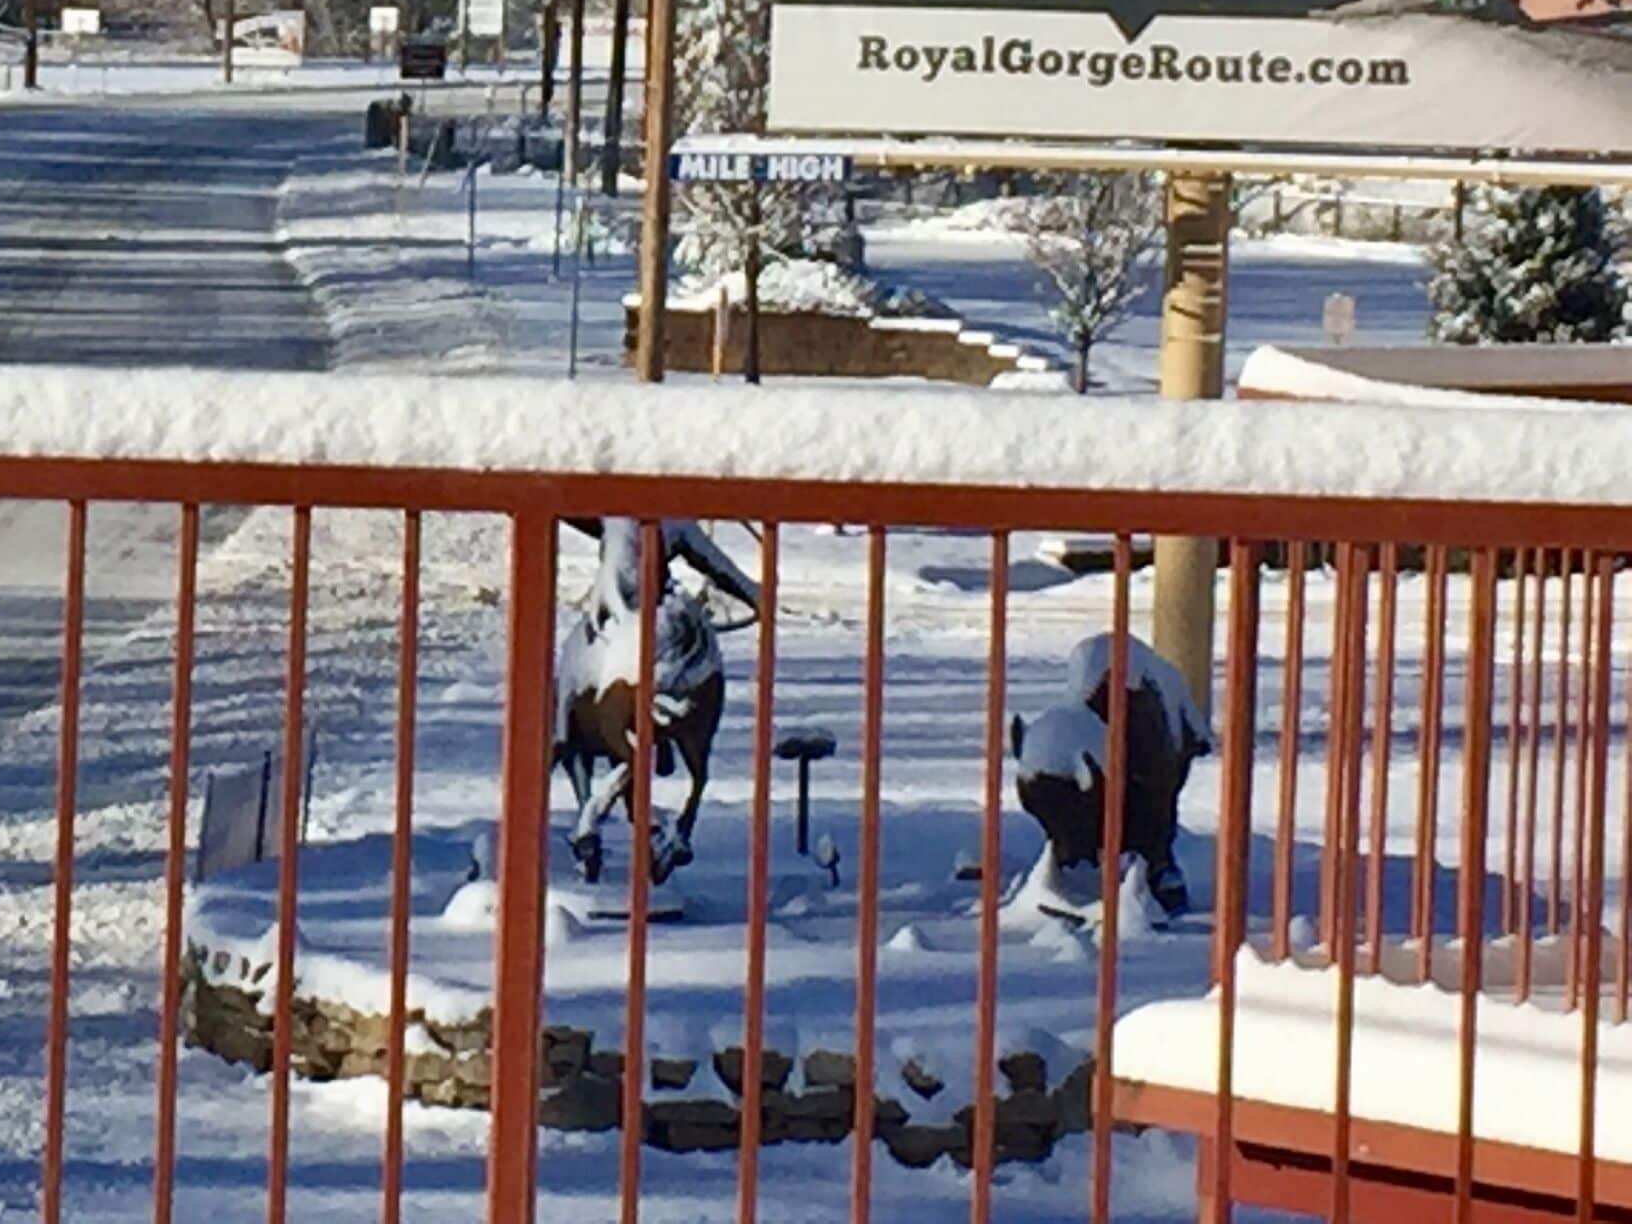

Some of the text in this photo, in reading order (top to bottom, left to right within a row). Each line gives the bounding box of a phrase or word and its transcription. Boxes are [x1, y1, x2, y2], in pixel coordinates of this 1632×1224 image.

[857, 35, 1410, 86] RoyalGorgeRoute.com
[678, 154, 844, 181] MILE HIGH
